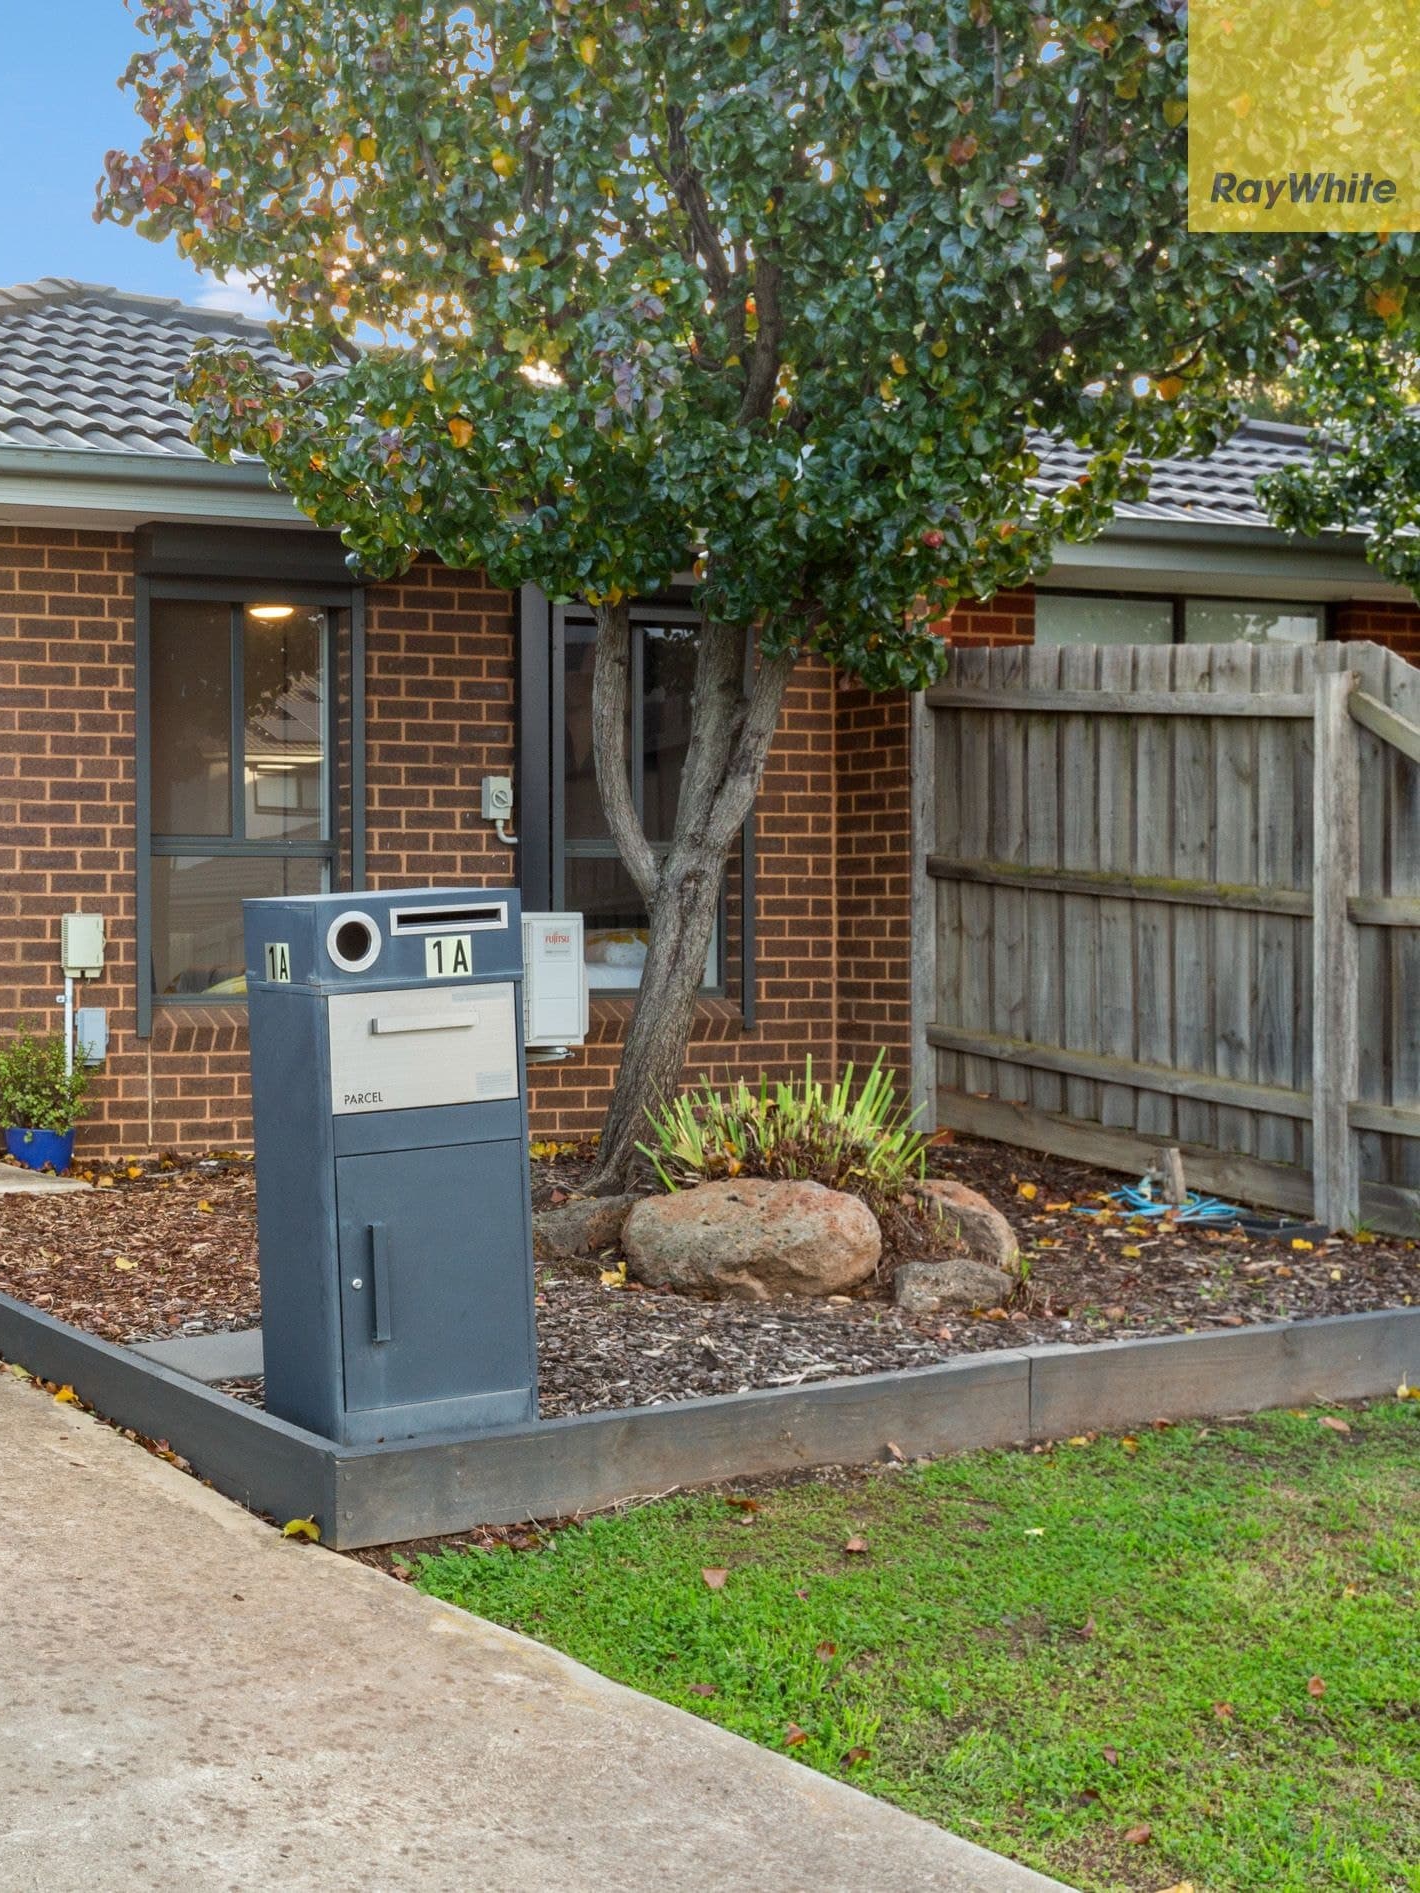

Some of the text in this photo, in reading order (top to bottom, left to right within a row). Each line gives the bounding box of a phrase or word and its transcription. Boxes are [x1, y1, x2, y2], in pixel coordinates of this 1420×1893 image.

[545, 931, 571, 943] FUJITSU
[269, 946, 289, 980] 1A
[432, 939, 469, 974] 1A
[344, 1091, 384, 1105] PARCEL
